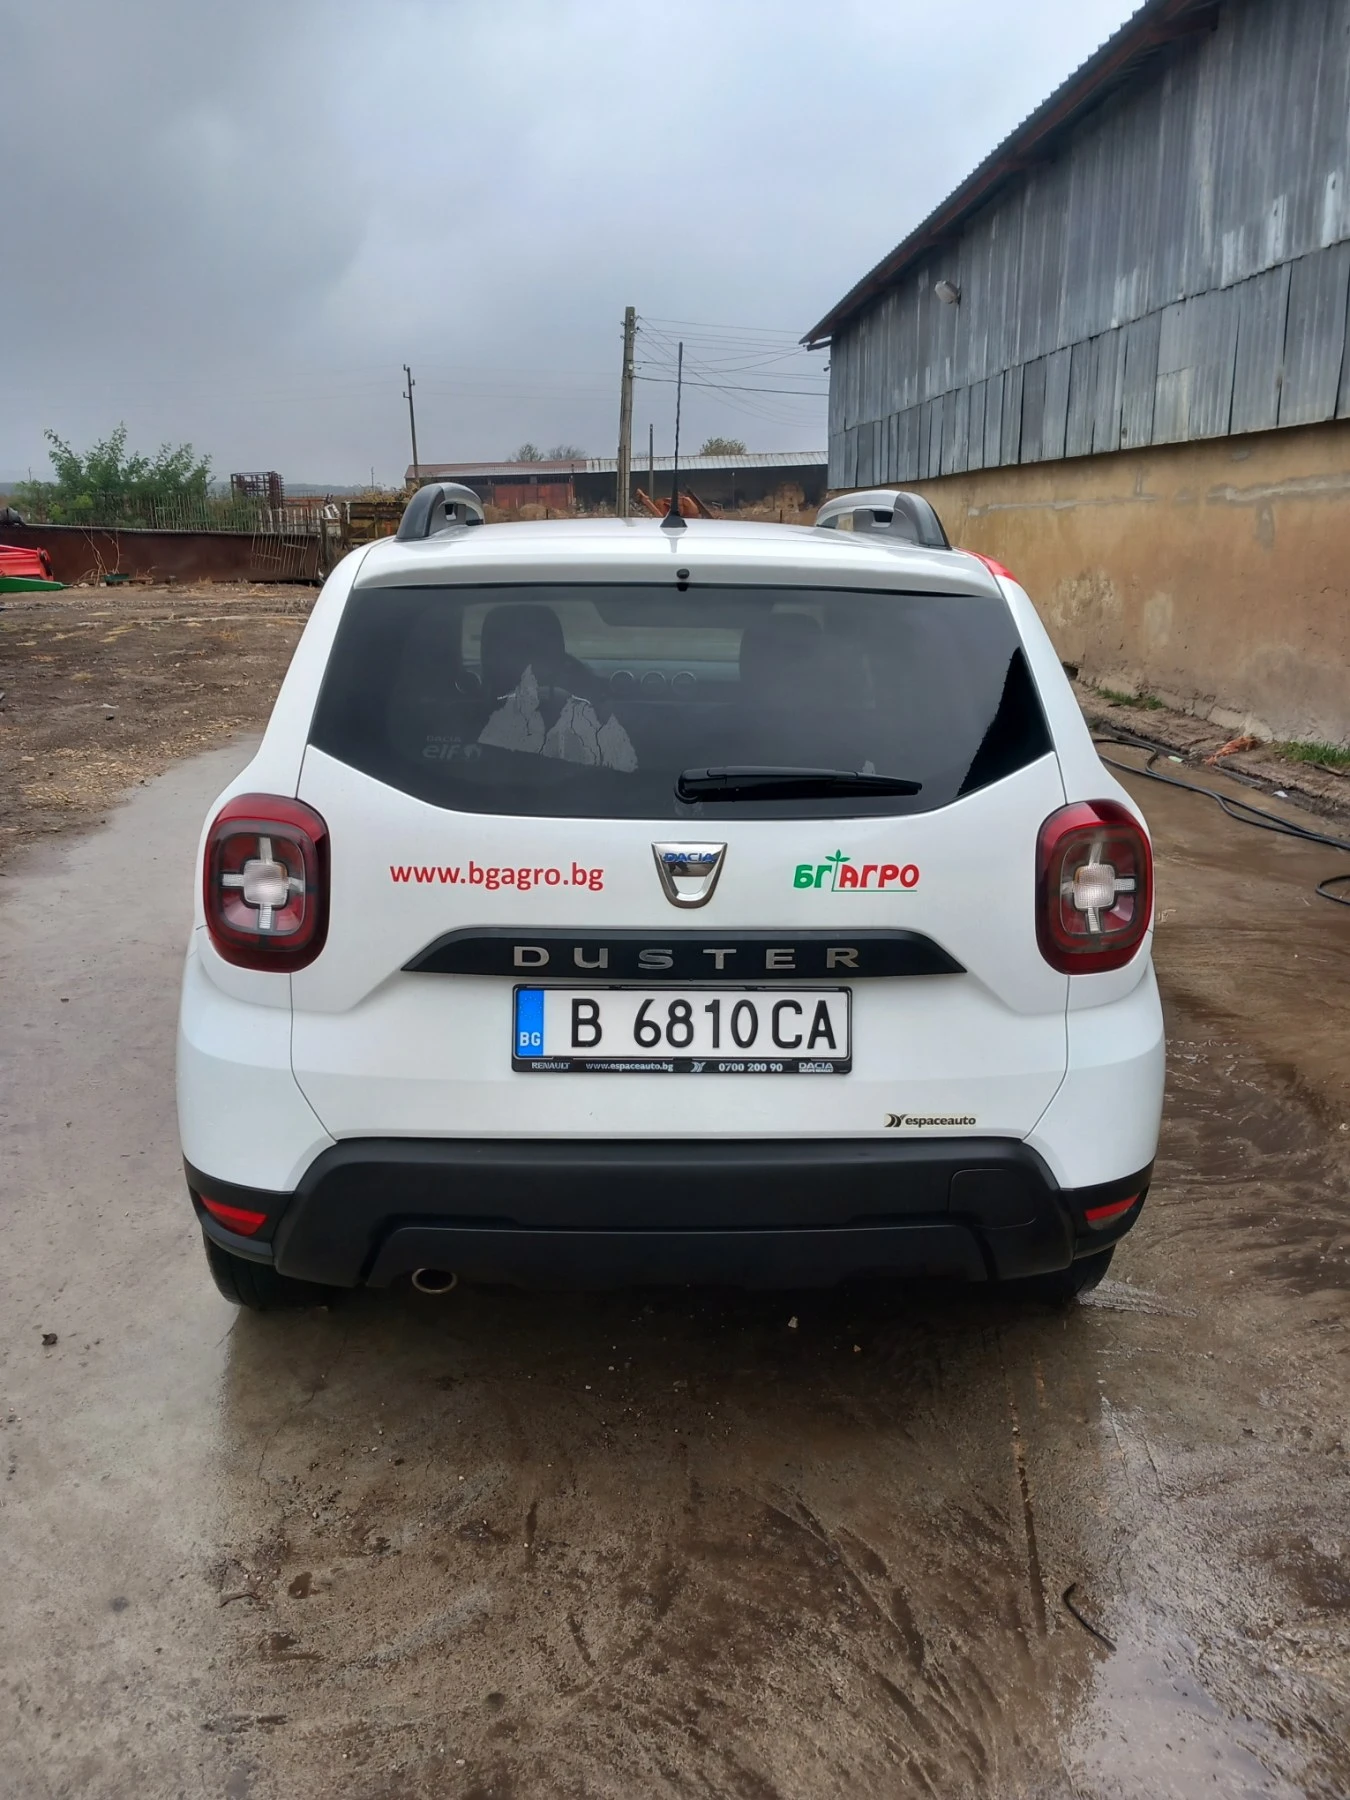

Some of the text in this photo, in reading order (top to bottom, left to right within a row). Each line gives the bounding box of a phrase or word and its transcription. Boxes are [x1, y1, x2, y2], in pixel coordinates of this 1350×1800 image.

[663, 852, 718, 863] DACIA
[390, 861, 604, 891] www.bgagro.bg
[513, 946, 860, 970] DUSTER
[519, 1032, 541, 1048] BG
[531, 1062, 674, 1072] RENAULT www.espaceauto.bg
[718, 1063, 783, 1072] 0700 200 90
[905, 1116, 977, 1128] espaceauto
